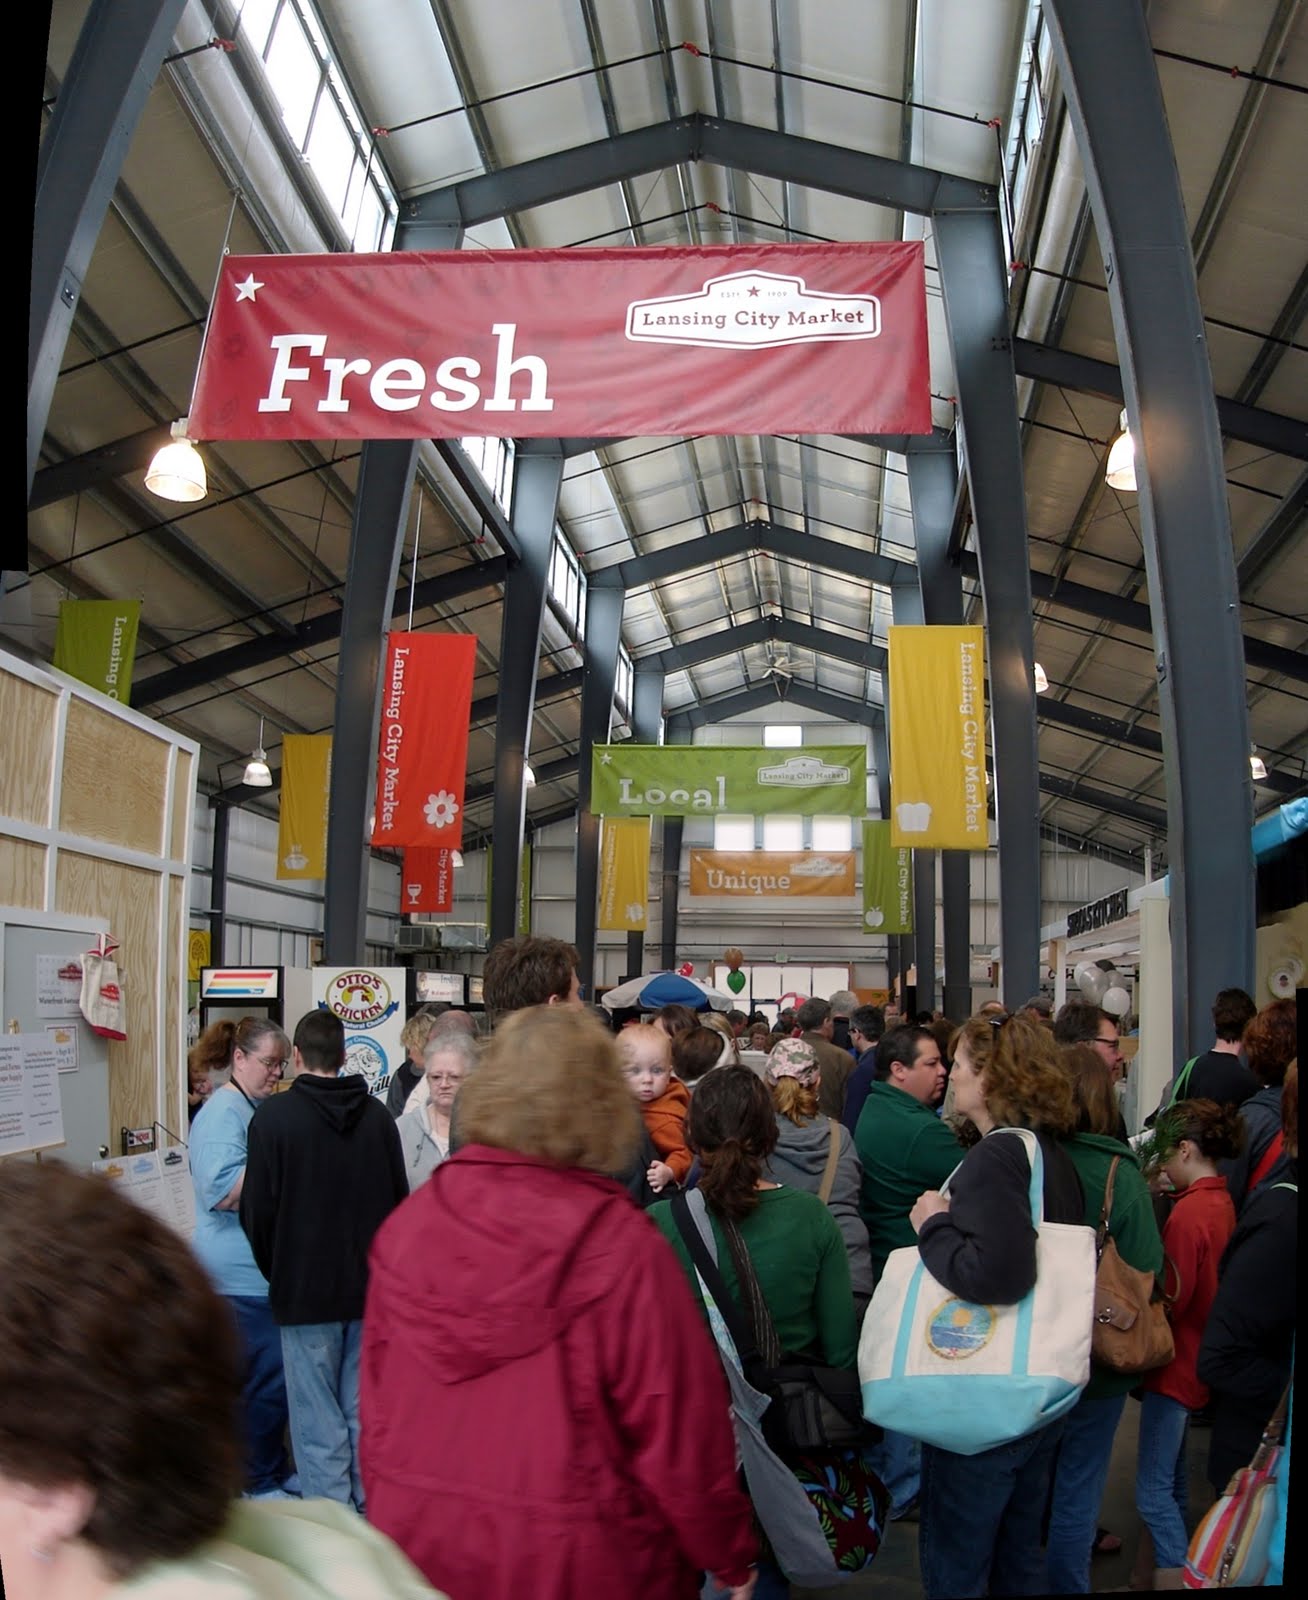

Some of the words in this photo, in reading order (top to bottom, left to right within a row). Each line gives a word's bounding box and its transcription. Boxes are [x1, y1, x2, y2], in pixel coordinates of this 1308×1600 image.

[643, 313, 727, 329] Lansing
[734, 311, 781, 329] City
[787, 308, 865, 326] Market
[257, 323, 555, 413] Fresh
[105, 615, 128, 685] Lansing
[386, 647, 410, 720] Lansing
[959, 642, 977, 716] Lansing
[383, 724, 403, 764] City
[961, 720, 978, 760] City
[619, 776, 727, 811] Local
[796, 772, 815, 780] City
[381, 767, 400, 831] Market
[965, 765, 983, 833] Market
[437, 848, 449, 869] City
[438, 870, 448, 905] Market
[706, 869, 791, 894] Unique
[897, 867, 909, 889] City
[899, 890, 910, 926] Market
[336, 974, 381, 990] OTTO'S
[333, 1002, 384, 1020] CHICKEN
